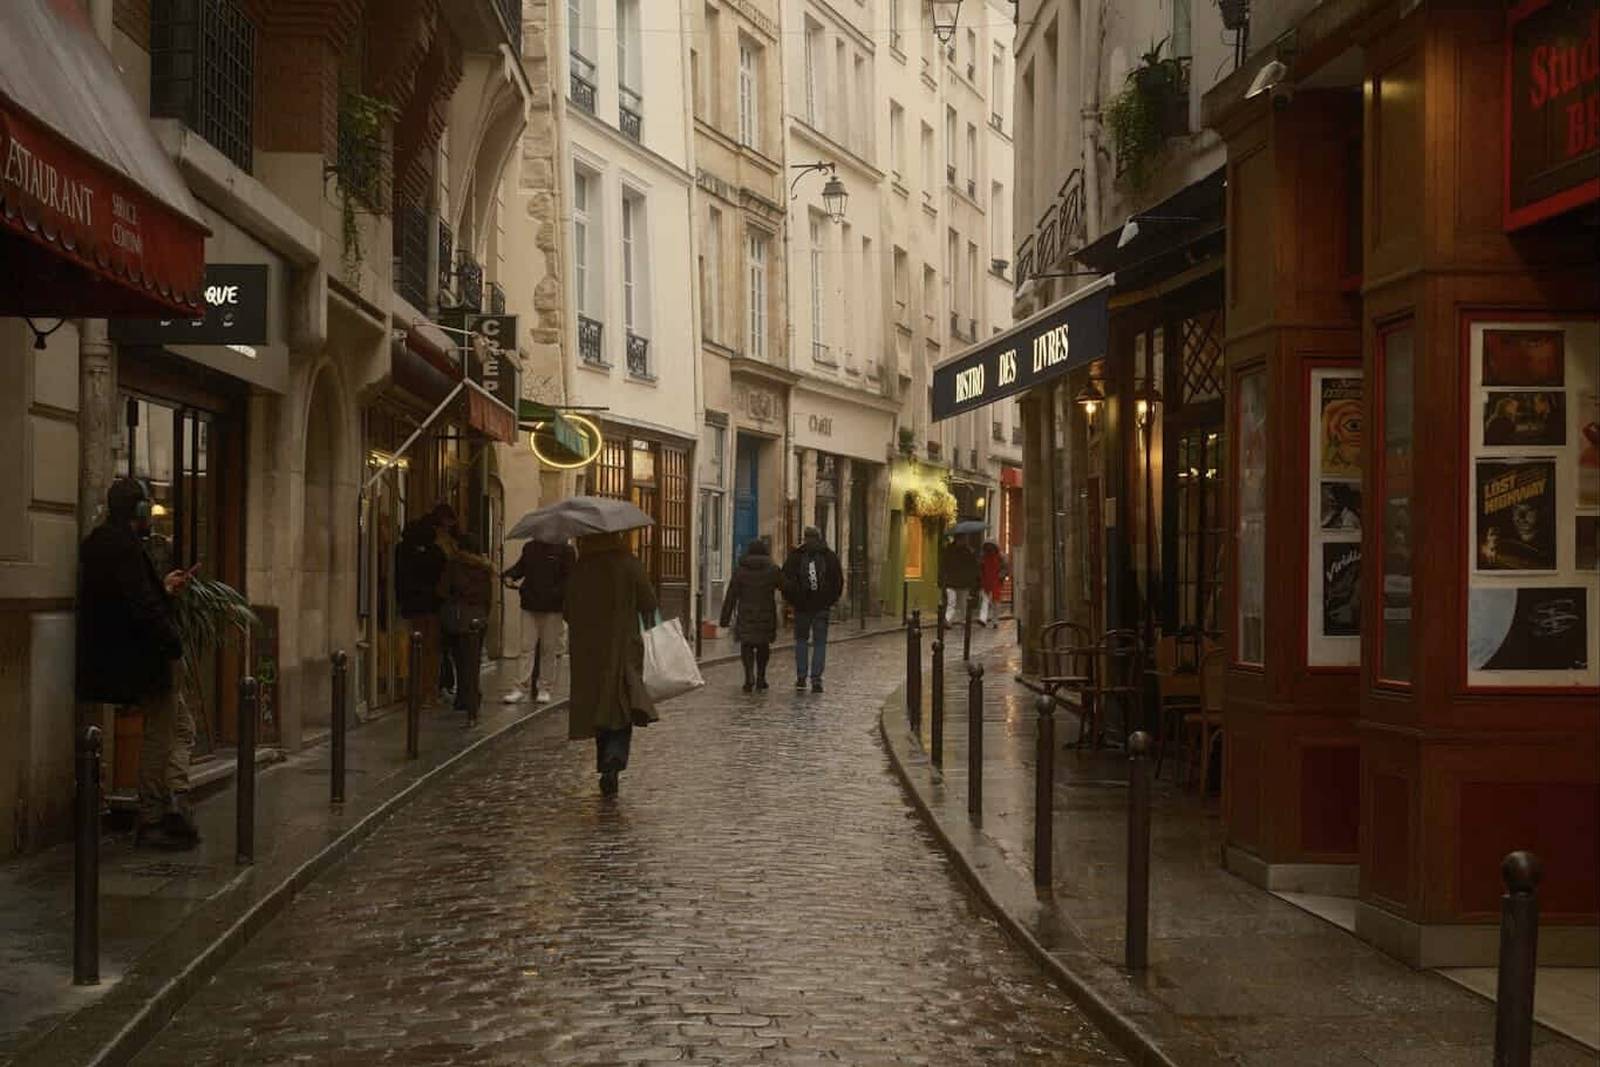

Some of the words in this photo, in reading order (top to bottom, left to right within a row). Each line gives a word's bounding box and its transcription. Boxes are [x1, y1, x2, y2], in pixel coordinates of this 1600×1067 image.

[3, 136, 95, 226] ESTAURANT
[204, 284, 240, 307] QUE
[955, 363, 985, 404] BISTRO
[998, 348, 1018, 388] DES
[1032, 323, 1070, 374] LIVRES
